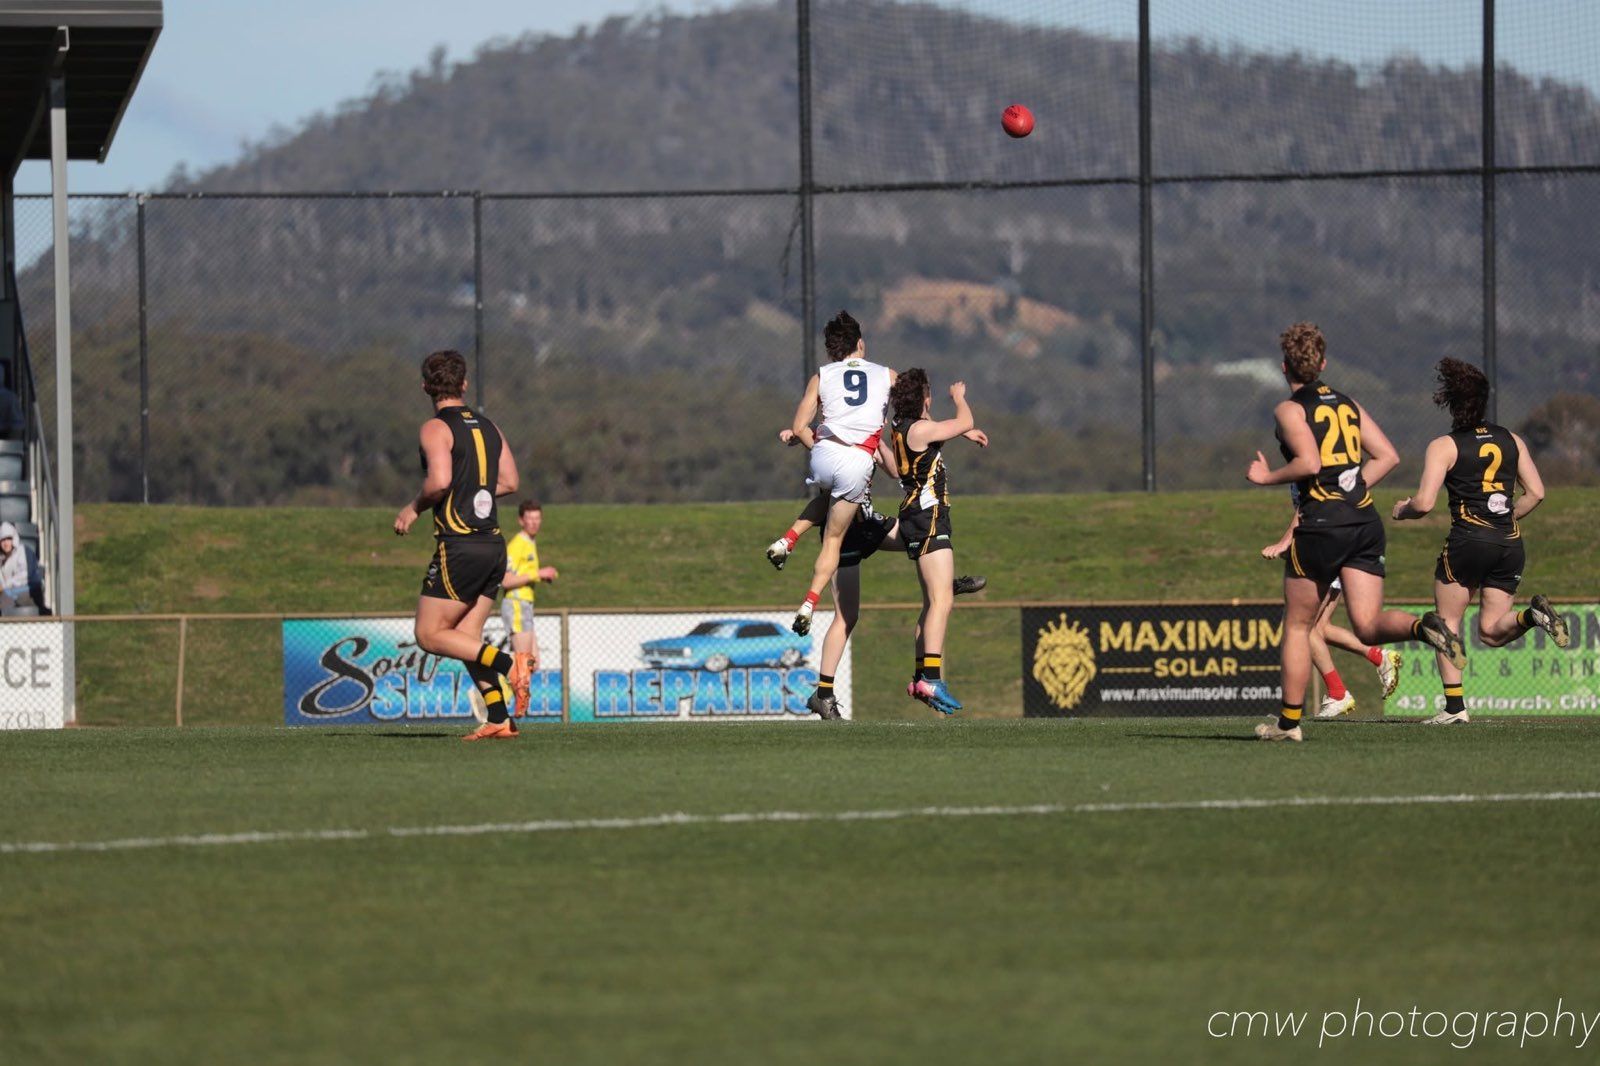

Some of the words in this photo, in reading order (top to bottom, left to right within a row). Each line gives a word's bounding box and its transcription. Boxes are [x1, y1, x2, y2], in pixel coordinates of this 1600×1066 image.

[843, 369, 868, 407] 9
[1314, 403, 1361, 467] 26
[471, 428, 487, 486] 1
[1479, 443, 1505, 492] 2
[1100, 619, 1284, 652] MAXIMUM
[3, 647, 51, 690] CE
[1153, 657, 1238, 678] SOLAR
[594, 668, 820, 717] REPAIRS
[1100, 685, 1282, 702] www.maximumsolar.com.a
[1396, 695, 1426, 710] 43
[1434, 694, 1552, 710] Ptriarch
[1560, 694, 1600, 710] Dri
